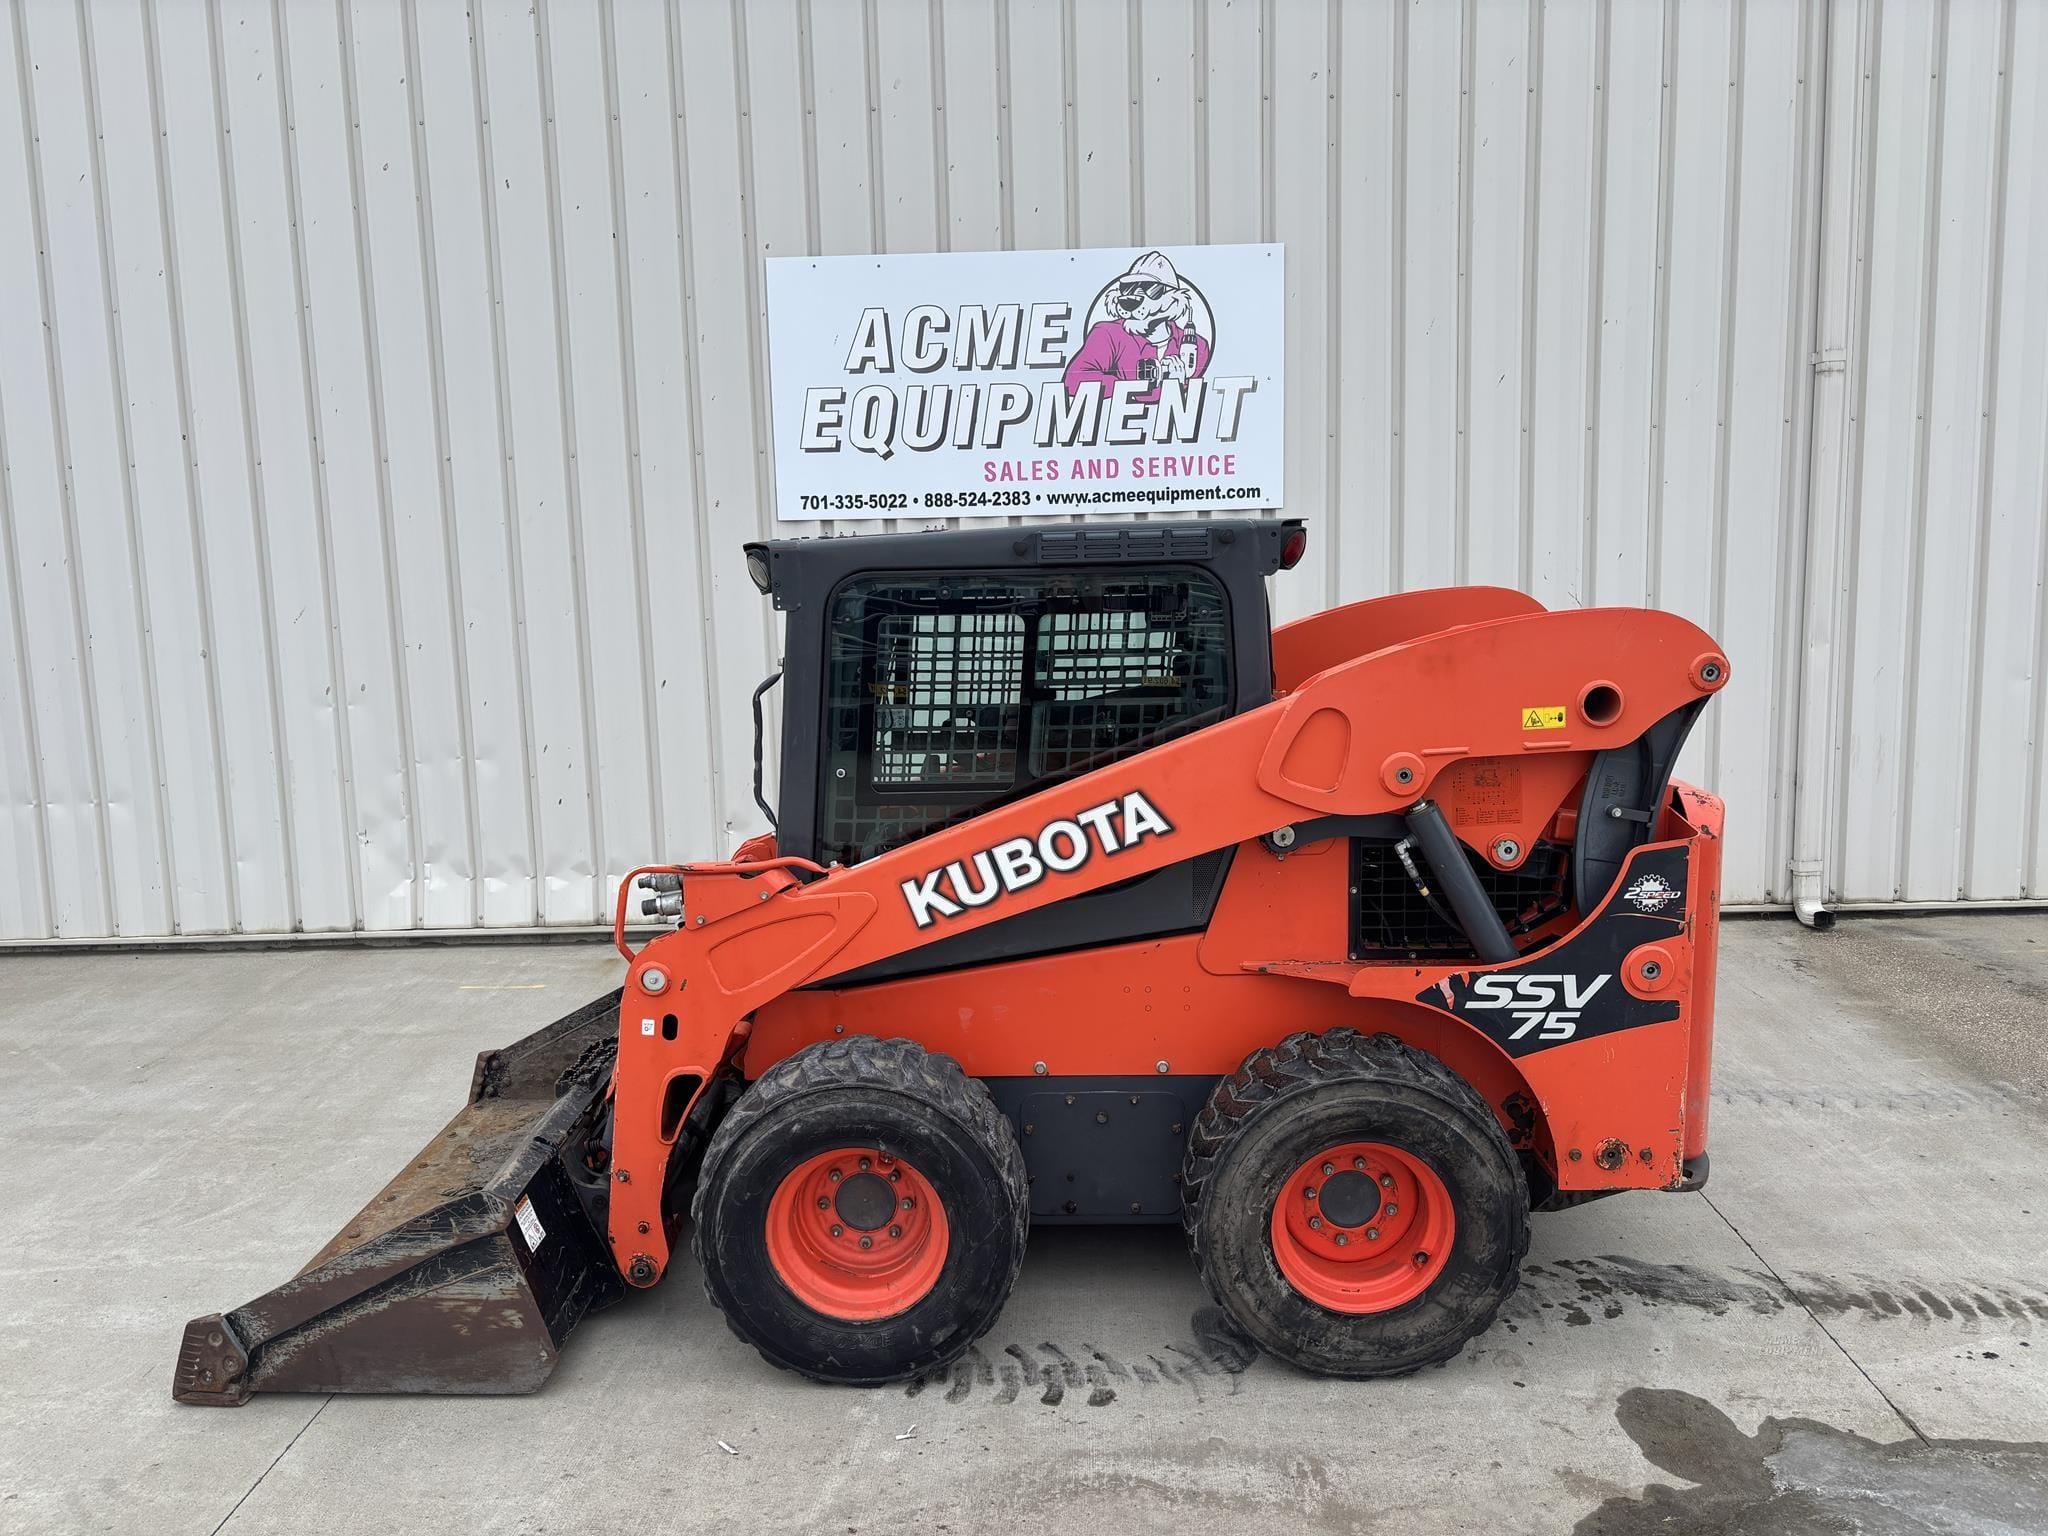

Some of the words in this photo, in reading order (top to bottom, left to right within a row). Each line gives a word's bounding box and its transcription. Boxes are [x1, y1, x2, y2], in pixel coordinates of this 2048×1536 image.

[844, 301, 1072, 374] ACME
[800, 375, 1259, 461] EQUIPMENT
[983, 459, 1060, 483] SALES
[1070, 457, 1120, 480] AND
[1131, 454, 1237, 479] SERVICE
[800, 494, 908, 510] 701-335-5022
[924, 490, 1031, 508] 888-524-2383
[1046, 485, 1261, 505] www.acmeequipment.com
[901, 791, 1173, 928] KUBOTA
[1464, 974, 1613, 1009] SSV
[1507, 1011, 1582, 1040] 75
